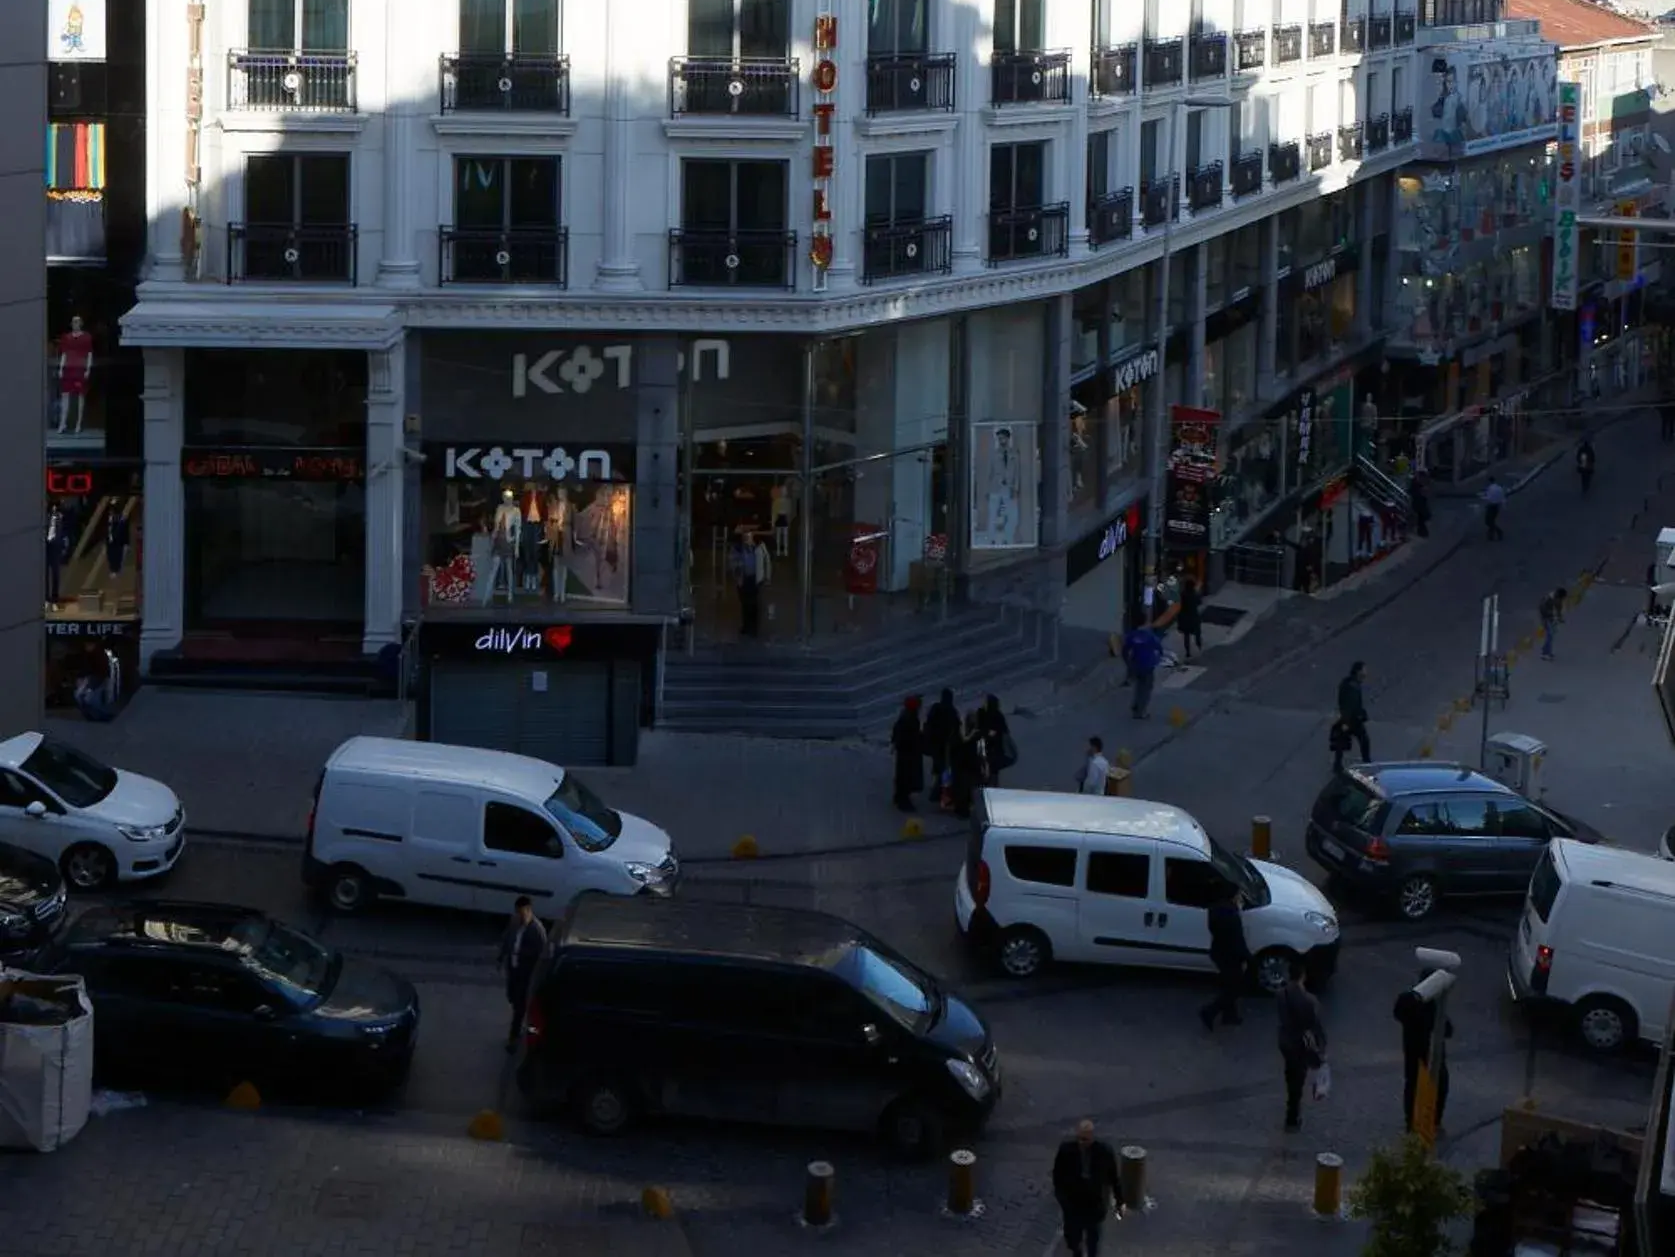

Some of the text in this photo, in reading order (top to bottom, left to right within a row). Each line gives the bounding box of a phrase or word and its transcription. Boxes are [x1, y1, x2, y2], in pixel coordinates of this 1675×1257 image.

[812, 13, 838, 222] HOTEL
[444, 446, 612, 480] KOTON
[87, 622, 123, 635] LIFE
